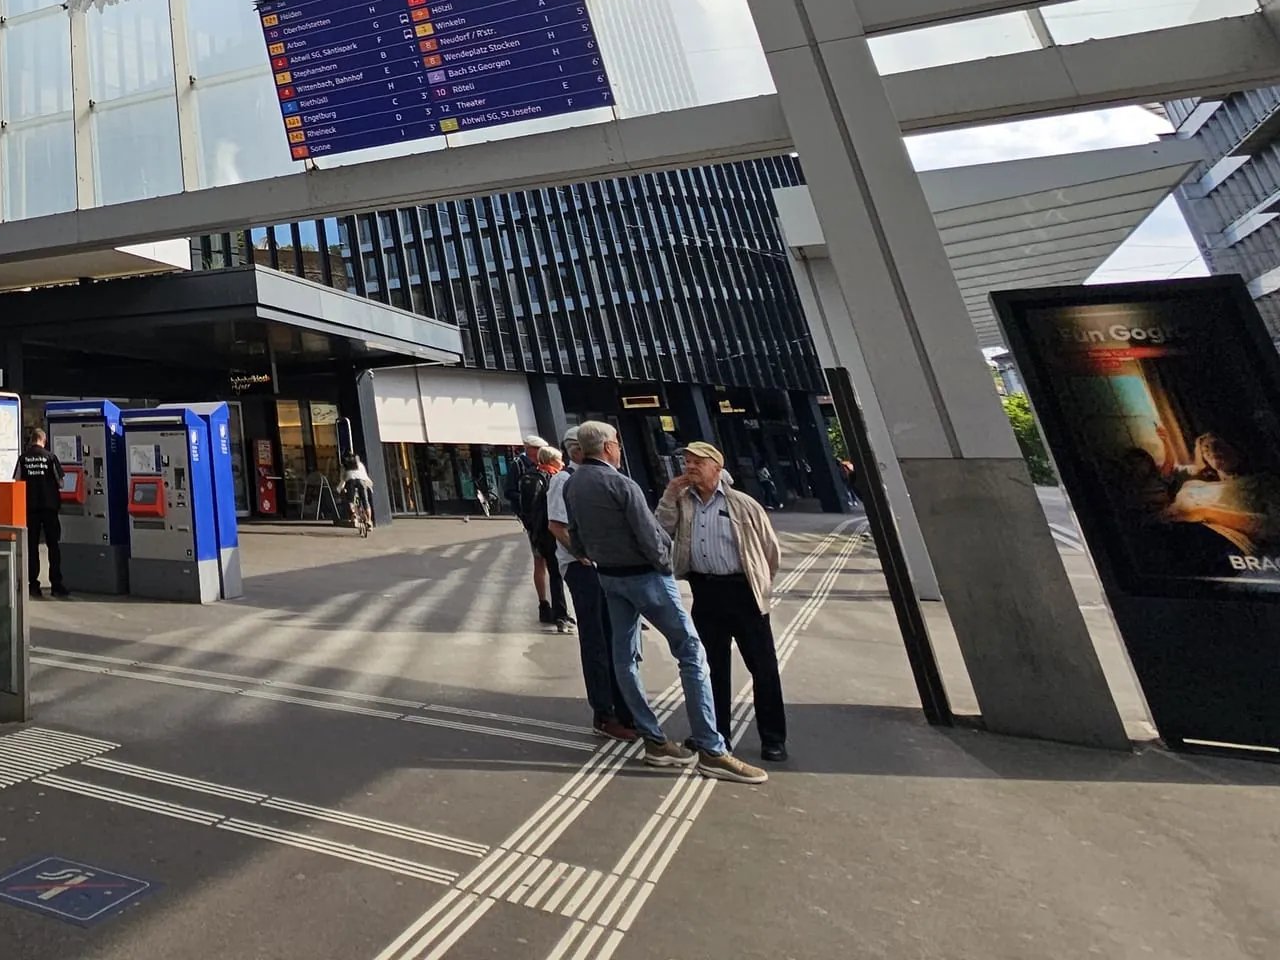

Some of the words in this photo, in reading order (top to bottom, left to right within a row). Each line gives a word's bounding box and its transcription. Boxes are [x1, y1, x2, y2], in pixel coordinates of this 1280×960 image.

[279, 10, 302, 20] Heiden
[431, 3, 453, 15] Hölzli
[270, 30, 278, 38] 10
[283, 18, 331, 35] Oberhofstetten
[286, 40, 307, 49] Arbon
[372, 20, 379, 28] G
[435, 18, 466, 30] Winkeln
[424, 41, 431, 49] 8
[439, 32, 470, 46] Neudorf
[443, 46, 488, 61] Wendeplatz
[488, 40, 521, 52] Stocken
[547, 31, 555, 39] H
[289, 53, 311, 64] Abtwil
[322, 41, 357, 56] Säntispark
[448, 66, 467, 77] Bach
[469, 59, 511, 73] St.Georgen
[551, 47, 560, 56] H
[293, 63, 337, 78] Stephanshorn
[296, 79, 335, 93] Wittenbach,
[334, 71, 363, 85] Bahnhof
[384, 66, 390, 74] E
[436, 88, 446, 96] 10
[452, 82, 475, 93] Röteli
[440, 104, 450, 112] 12
[456, 98, 487, 110] Theater
[562, 81, 569, 89] E
[299, 95, 328, 108] Riethüsli
[303, 111, 337, 122] Engelburg
[391, 97, 398, 105] C
[461, 114, 487, 126] Abtwil
[487, 112, 501, 120] SG,
[500, 105, 542, 119] St.Josefen
[567, 98, 575, 106] F
[306, 125, 336, 138] Rheineck
[395, 113, 402, 121] D
[310, 144, 331, 152] Sonne
